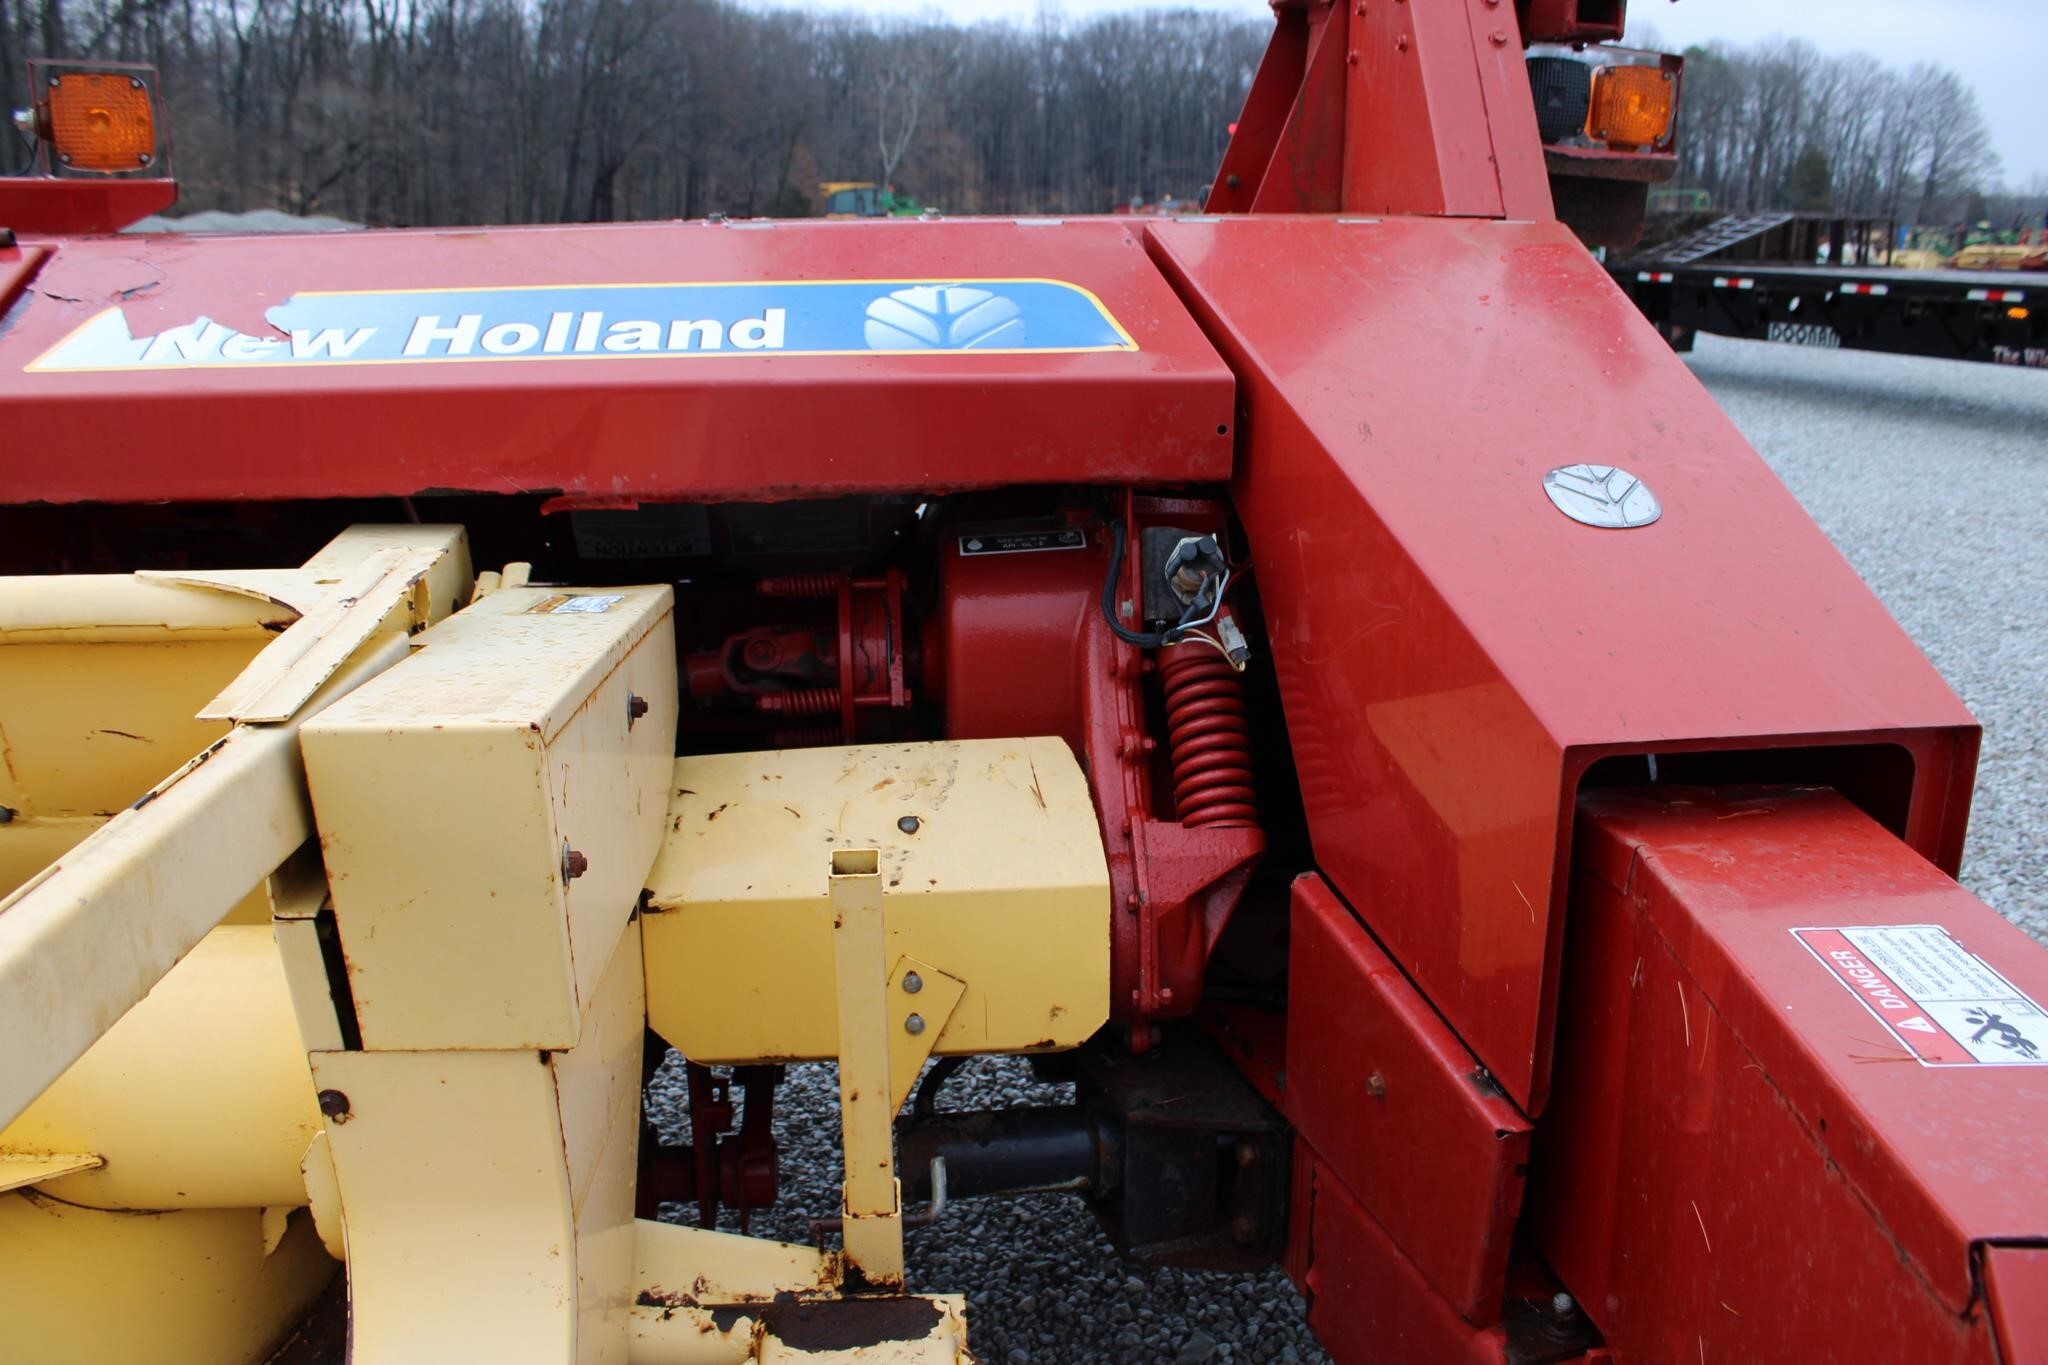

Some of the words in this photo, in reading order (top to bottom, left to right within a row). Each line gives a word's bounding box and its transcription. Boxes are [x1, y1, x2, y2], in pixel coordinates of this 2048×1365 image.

[140, 321, 379, 361] New
[401, 308, 786, 355] Holland
[594, 543, 692, 554] ATTENTION
[1829, 950, 1909, 1009] DANGER
